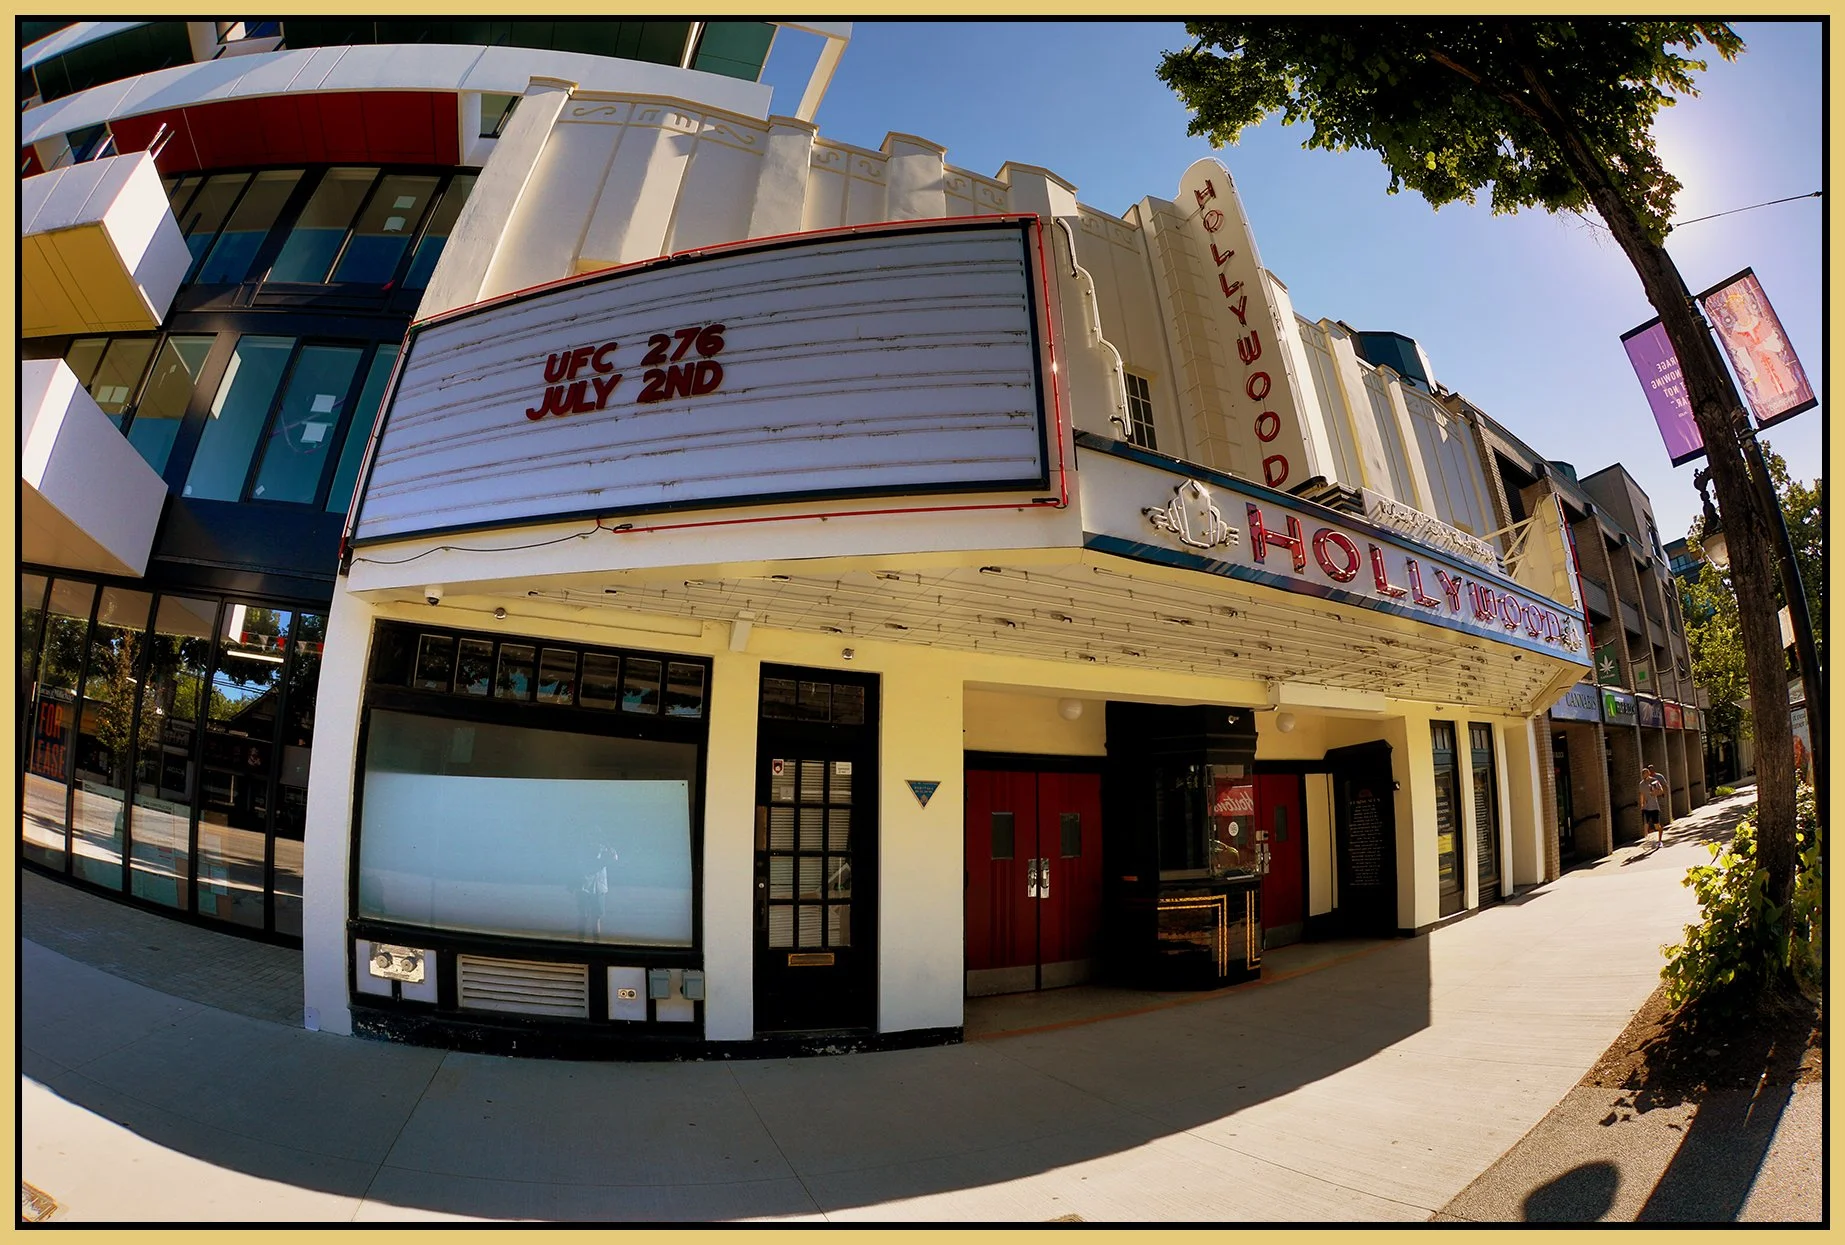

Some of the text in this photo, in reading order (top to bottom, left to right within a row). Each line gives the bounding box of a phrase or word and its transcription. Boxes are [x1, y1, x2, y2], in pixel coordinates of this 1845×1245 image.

[543, 324, 726, 384] UFC 276
[1194, 179, 1290, 489] HOLLYWOOD
[525, 360, 724, 421] JULY 2ND
[1246, 502, 1562, 643] HOLLYWOOD
[39, 701, 65, 739] FOR
[1565, 691, 1598, 711] CANNABIS
